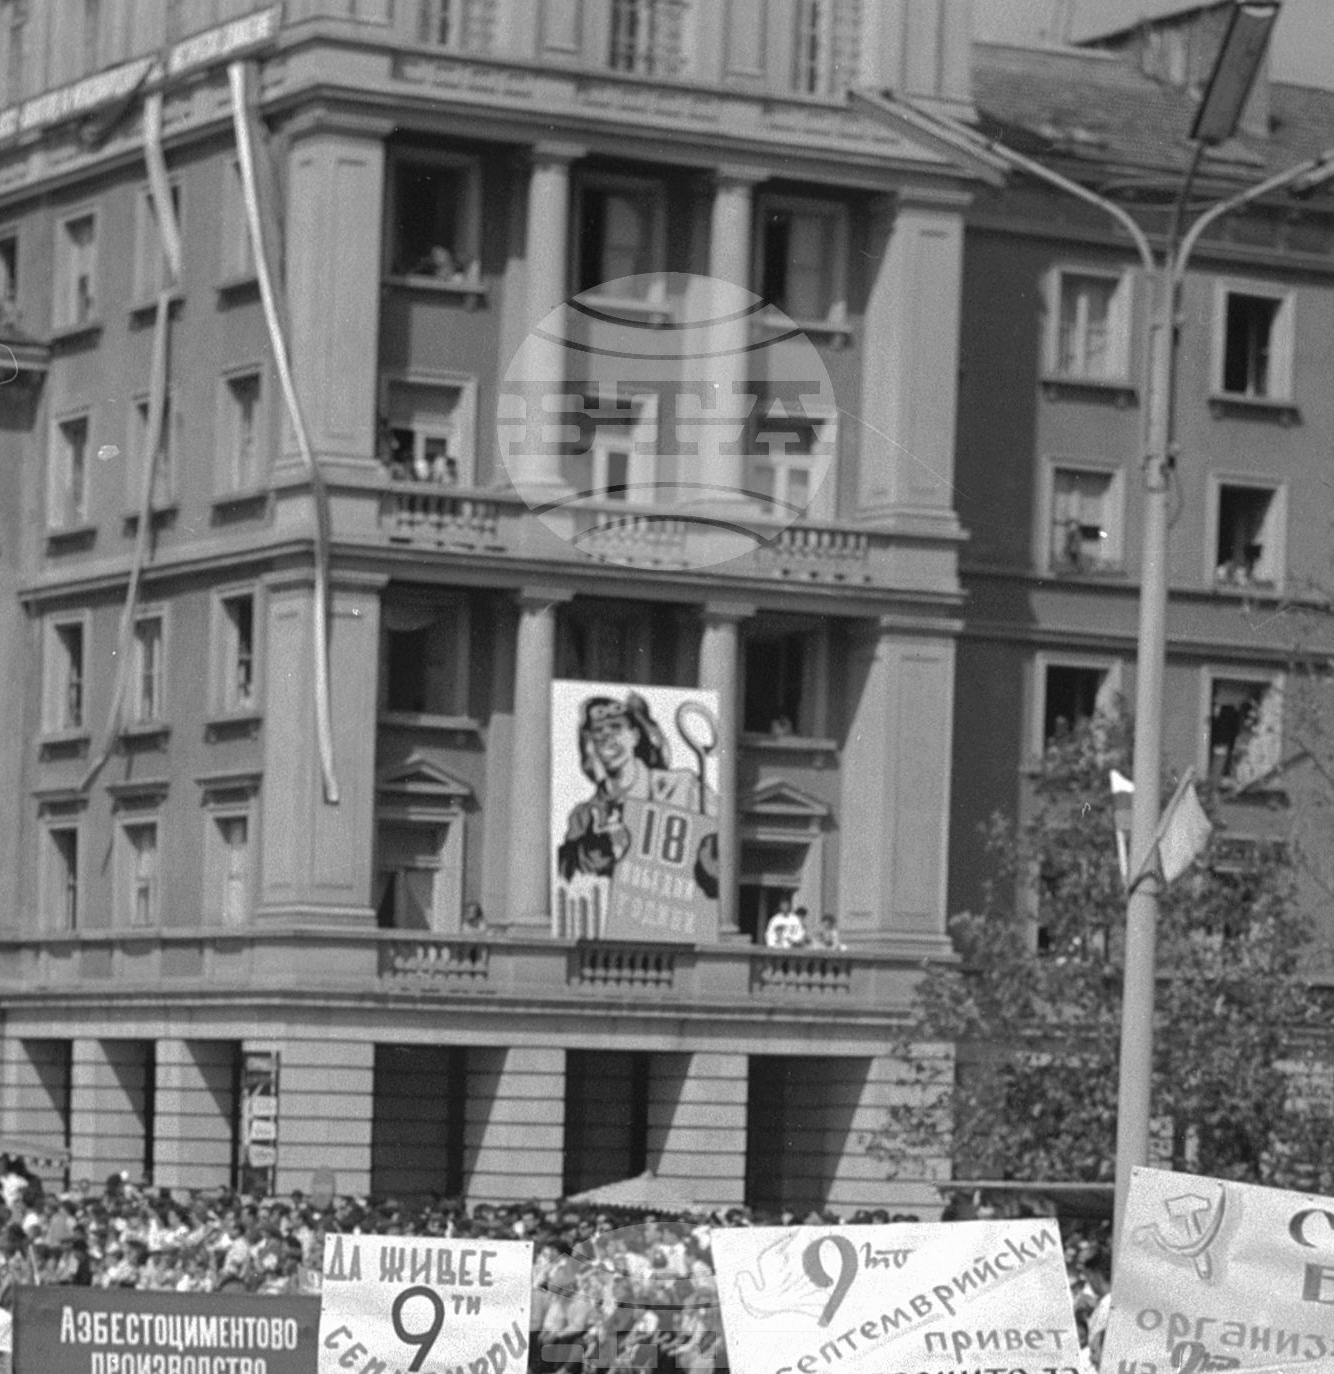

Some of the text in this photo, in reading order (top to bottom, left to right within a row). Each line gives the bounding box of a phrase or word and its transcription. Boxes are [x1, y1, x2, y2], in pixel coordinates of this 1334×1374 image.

[642, 809, 688, 864] 18
[325, 1236, 362, 1282] ДА
[379, 1246, 497, 1287] ЖИВЕЕ
[924, 1327, 1069, 1364] привет
